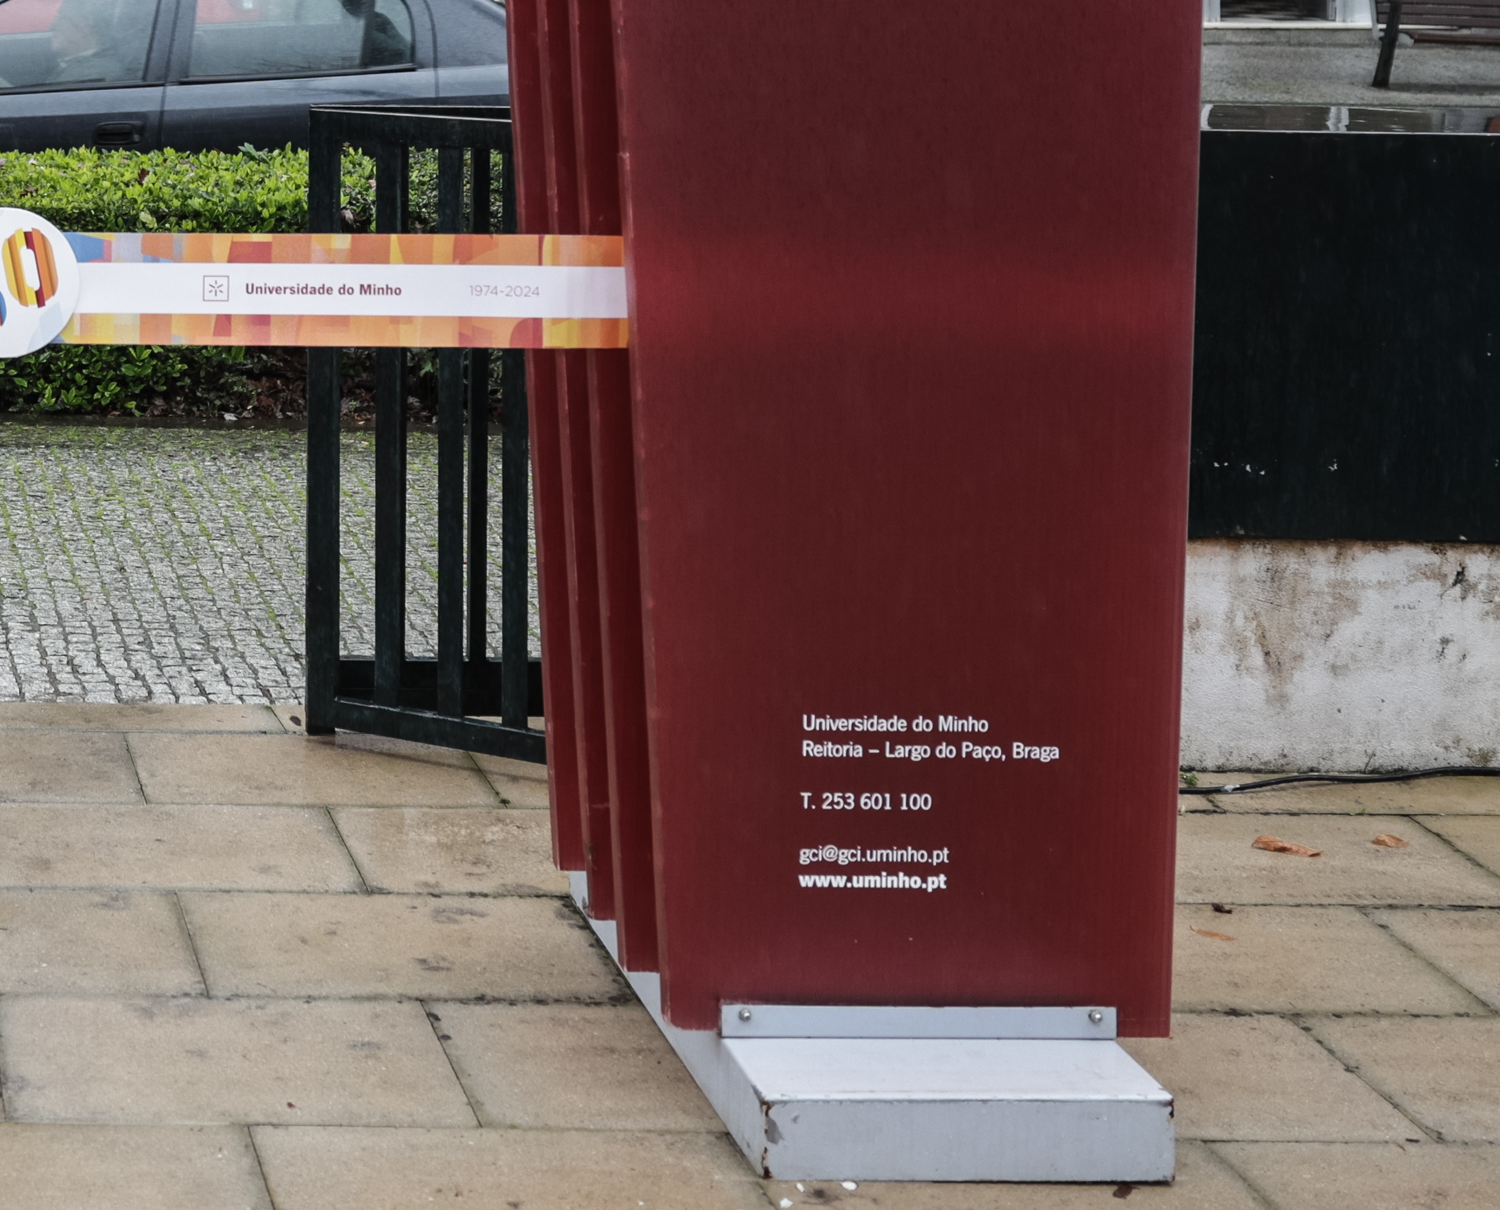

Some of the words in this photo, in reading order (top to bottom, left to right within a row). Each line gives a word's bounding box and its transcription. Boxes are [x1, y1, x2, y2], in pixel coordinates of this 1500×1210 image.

[245, 282, 334, 296] Universidade
[337, 283, 355, 296] do
[359, 283, 402, 296] Minho
[469, 284, 541, 298] 1974-2024
[802, 714, 908, 732] Universidade
[911, 715, 934, 733] do
[938, 714, 989, 733] Minho
[802, 739, 863, 758] Reitoria
[885, 741, 931, 762] Largo
[935, 741, 957, 759] do
[961, 741, 1006, 762] Paço,
[1012, 741, 1060, 763] Braga
[800, 791, 816, 810] T.
[821, 792, 855, 810] 253
[859, 792, 892, 811] 601
[900, 793, 932, 811] 100
[798, 844, 950, 867] gci@gci.uminho.pt
[798, 871, 947, 893] www.uminho.pt
